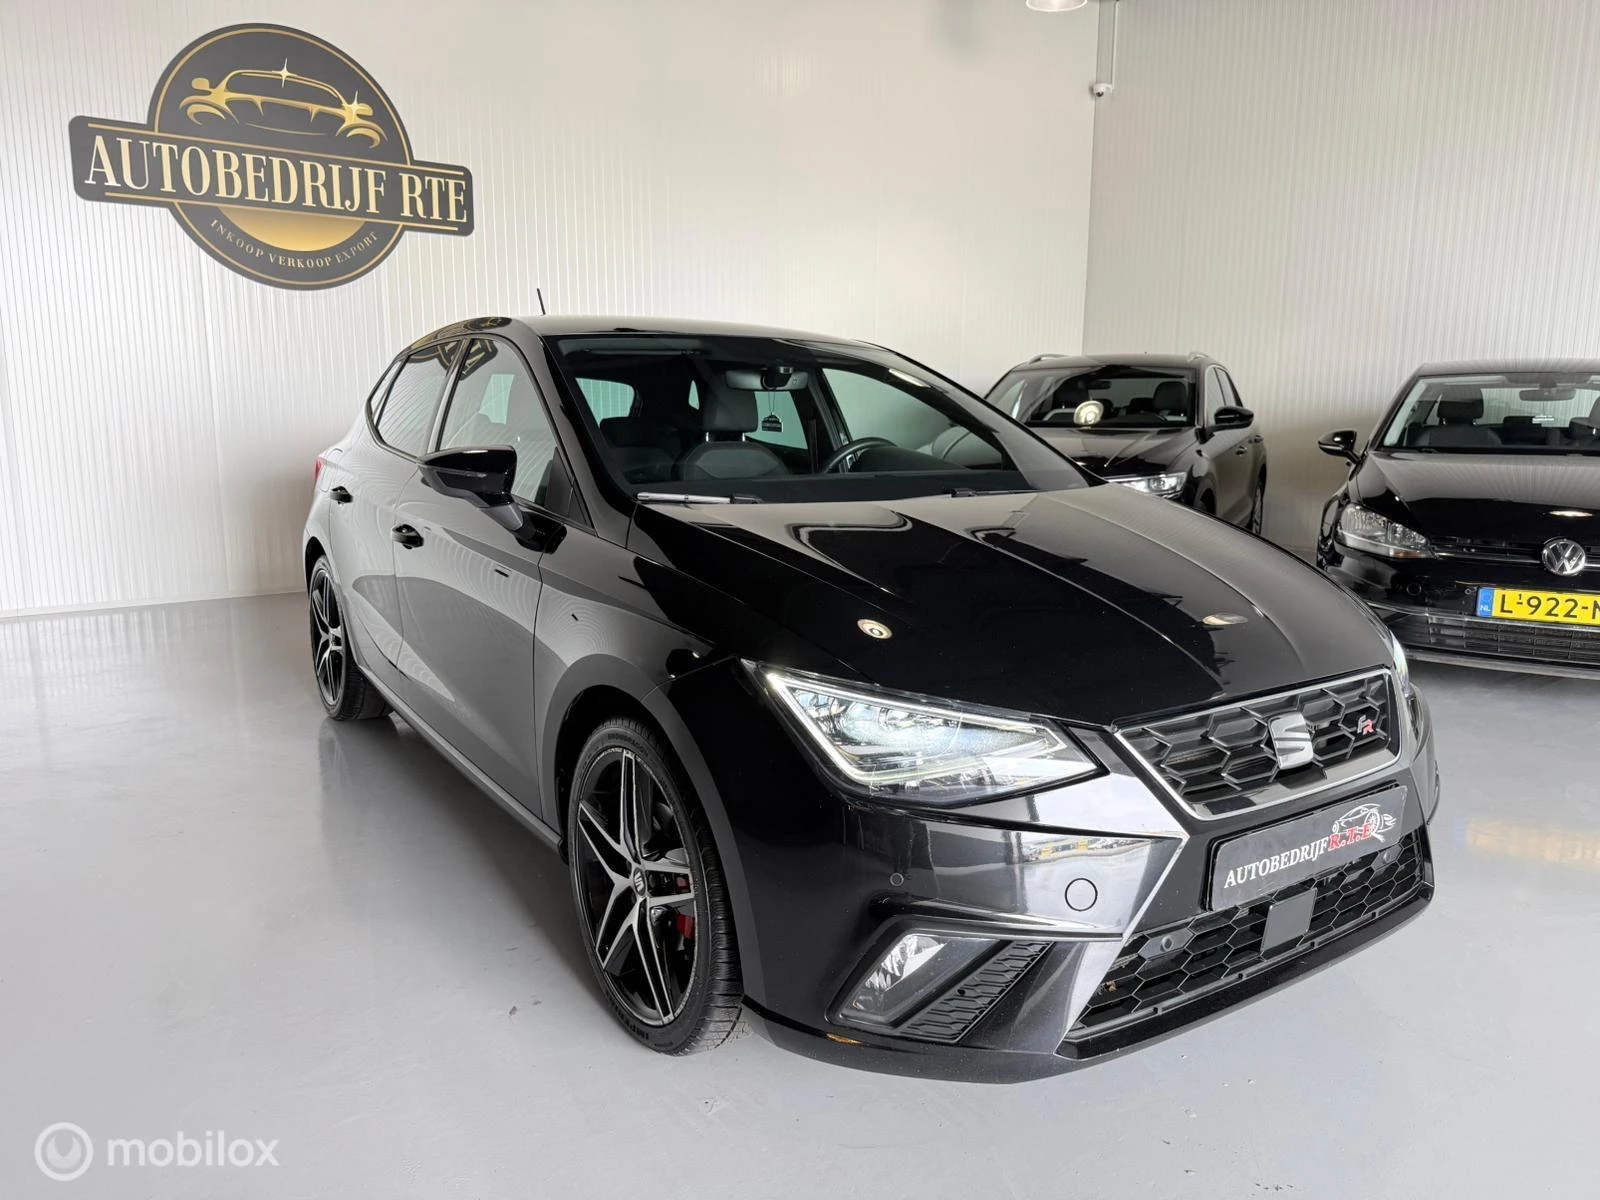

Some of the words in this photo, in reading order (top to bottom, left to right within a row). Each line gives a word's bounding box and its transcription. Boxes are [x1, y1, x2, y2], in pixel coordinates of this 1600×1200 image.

[84, 135, 386, 213] AUTOBEDRIJF
[399, 173, 467, 222] RTE
[210, 219, 264, 258] INKOOP
[269, 254, 332, 269] VERKOOP
[335, 231, 378, 263] EXPORT
[1223, 837, 1329, 889] AUTOBEDRIJF
